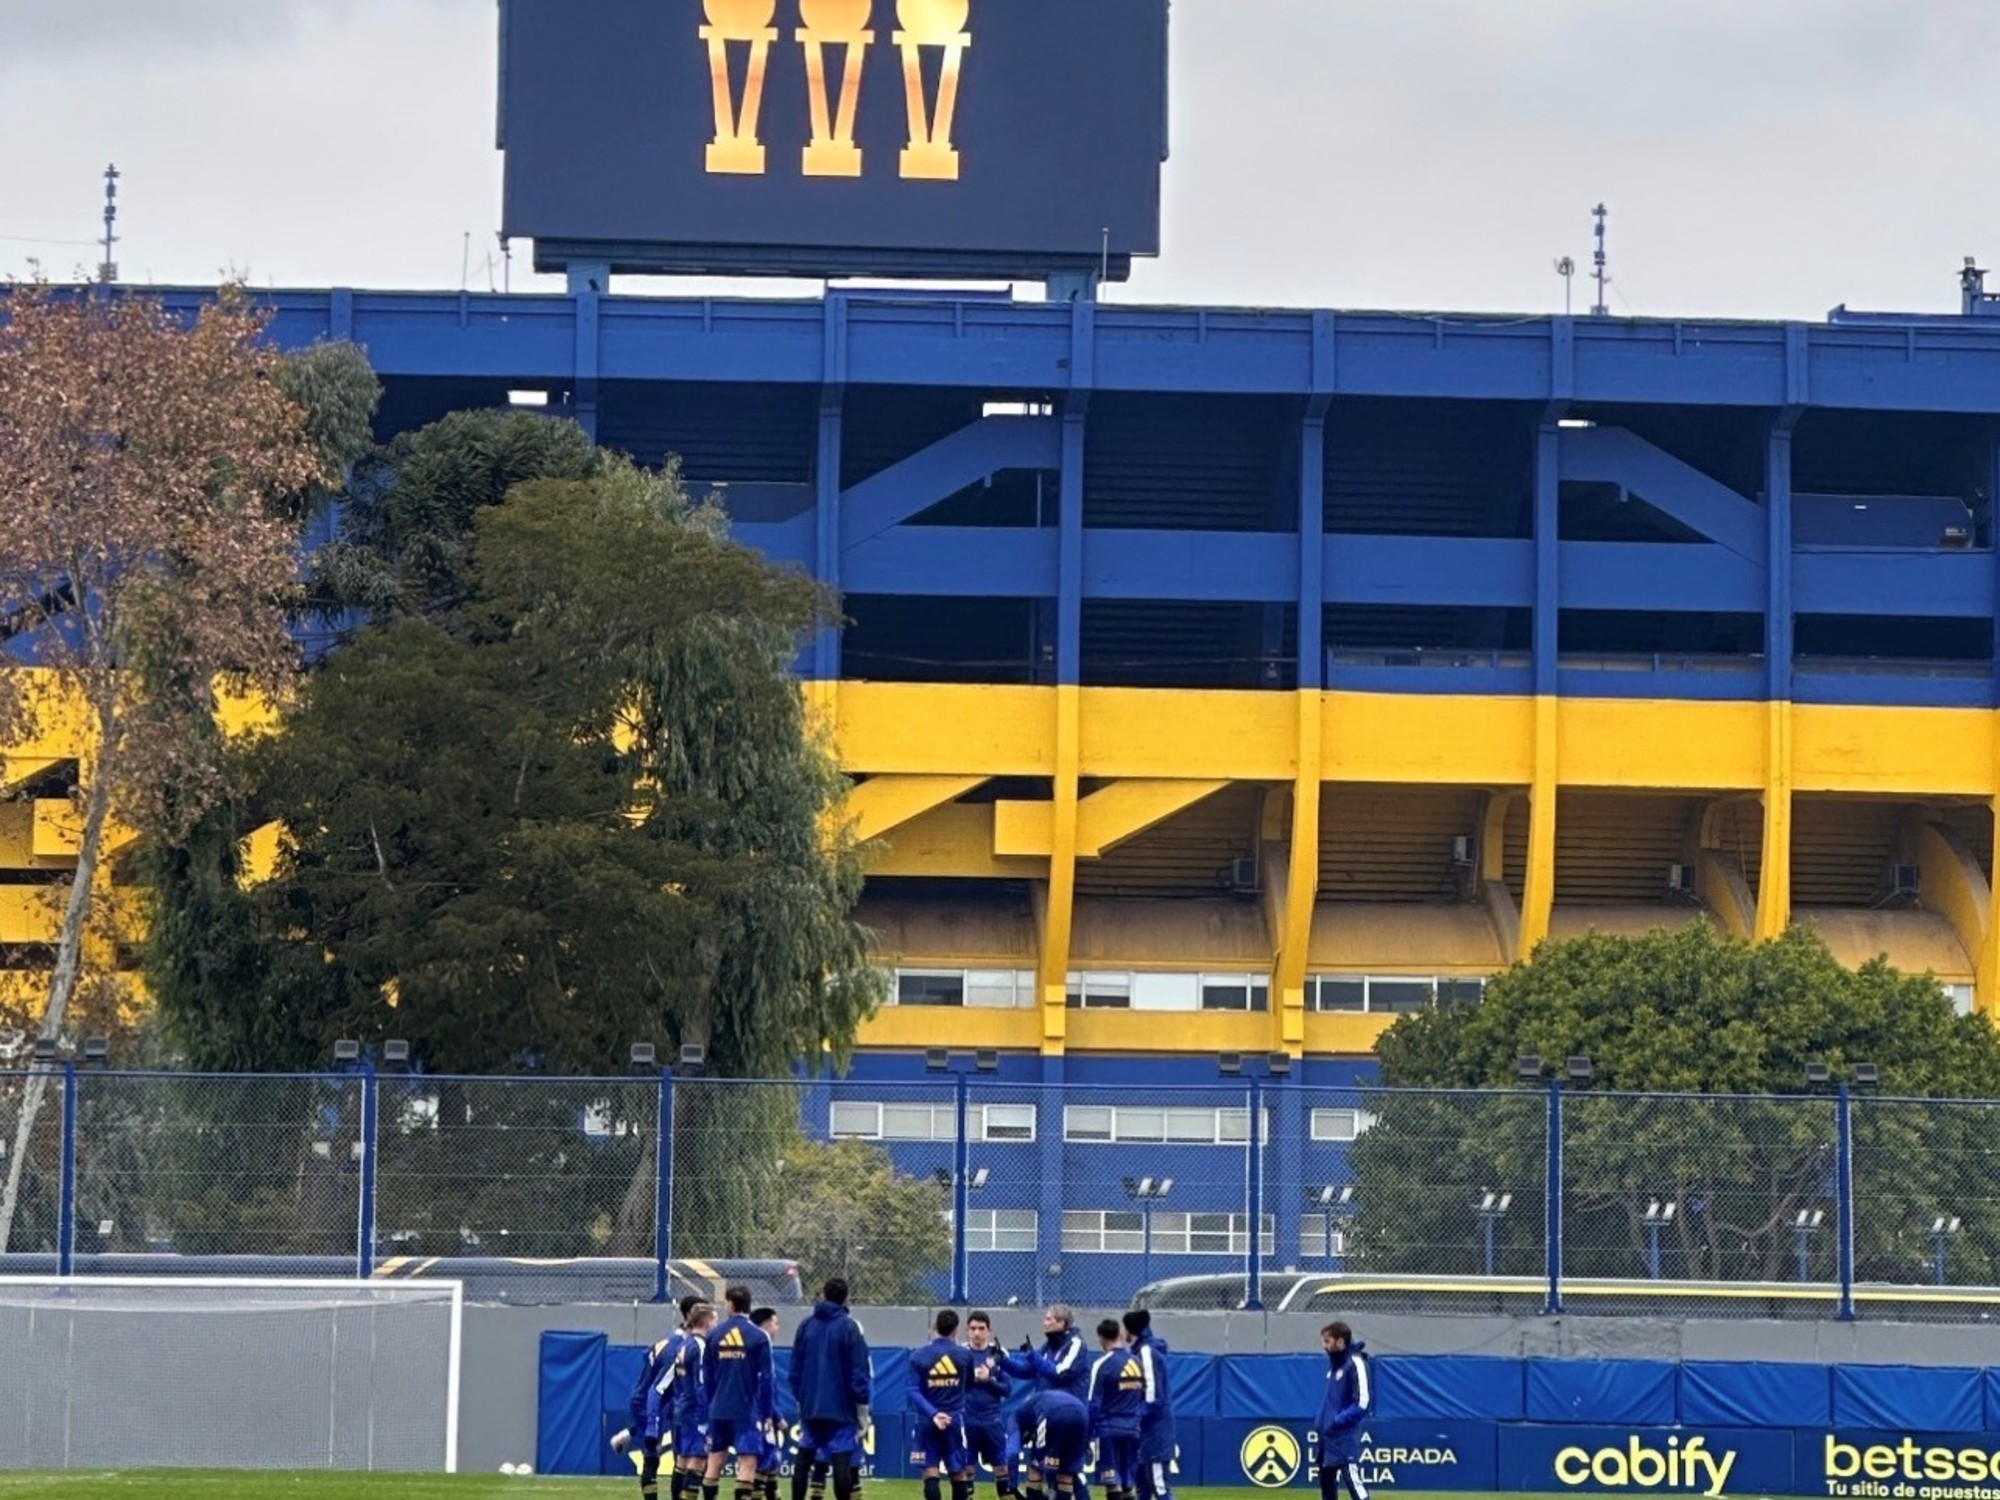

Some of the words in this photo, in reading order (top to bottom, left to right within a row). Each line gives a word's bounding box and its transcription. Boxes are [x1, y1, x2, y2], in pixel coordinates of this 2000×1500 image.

[1358, 1447, 1457, 1464] AGRADA
[1554, 1435, 1737, 1496] cabify
[1826, 1480, 1847, 1495] Tu
[1851, 1480, 1889, 1497] sitio
[1892, 1481, 1916, 1498] de
